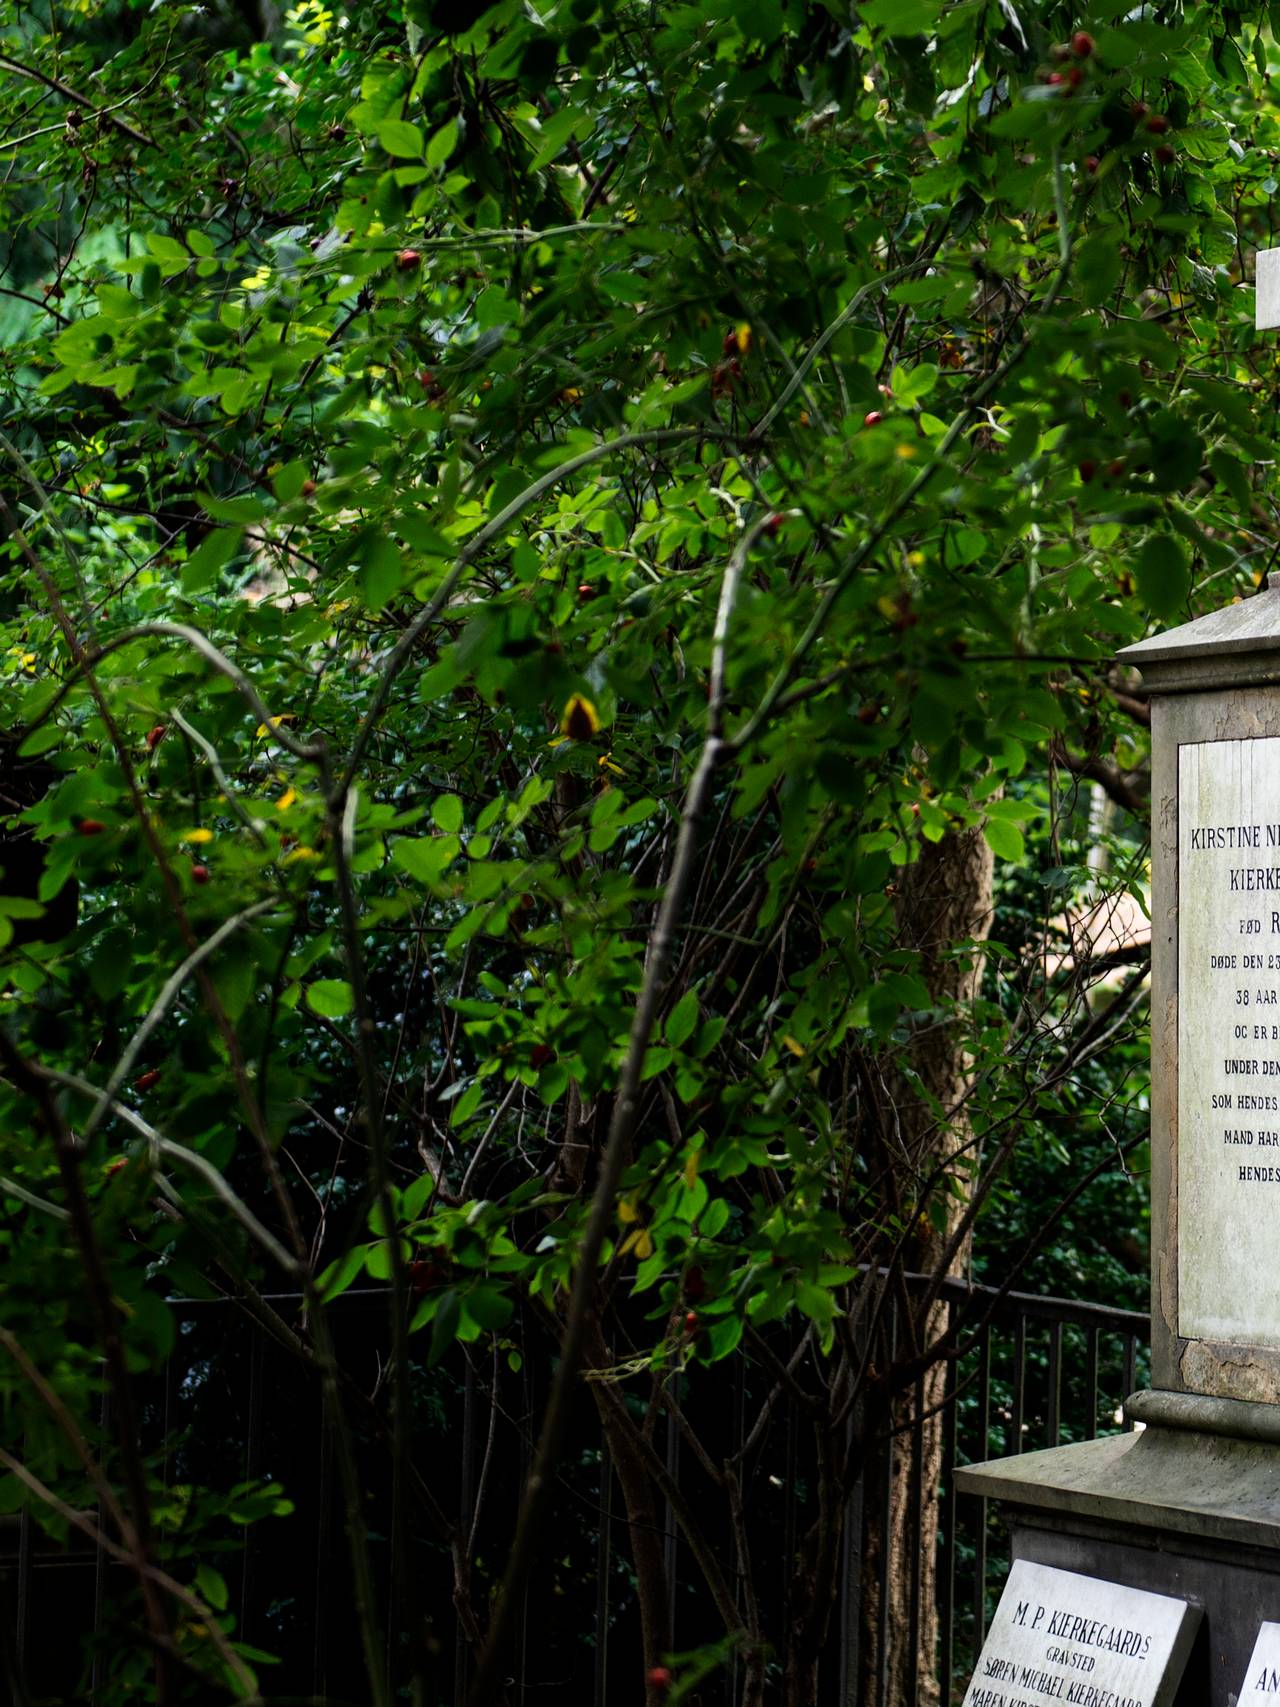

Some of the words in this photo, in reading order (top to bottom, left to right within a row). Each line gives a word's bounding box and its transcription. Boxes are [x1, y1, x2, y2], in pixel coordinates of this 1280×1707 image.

[1191, 826, 1260, 850] KIRSTINE
[1239, 919, 1261, 935] FØD
[1211, 955, 1237, 969] DØDE
[1243, 955, 1264, 969] DEN
[1268, 955, 1280, 970] 23
[1235, 990, 1249, 1006] 38
[1256, 990, 1278, 1005] AAR
[1254, 1025, 1268, 1040] ER
[1224, 1060, 1260, 1075] UNDER
[1212, 1094, 1232, 1109] SOM
[1237, 1095, 1278, 1110] HENDES
[1224, 1130, 1254, 1145] MAND
[1258, 1131, 1280, 1147] HAR
[1239, 1166, 1280, 1183] HENDES
[1012, 1600, 1030, 1627] M.
[1031, 1606, 1046, 1630] P.
[1046, 1646, 1096, 1673] GRAVSTED
[983, 1656, 1018, 1683] SØREN
[1018, 1667, 1065, 1699] MICHAEL
